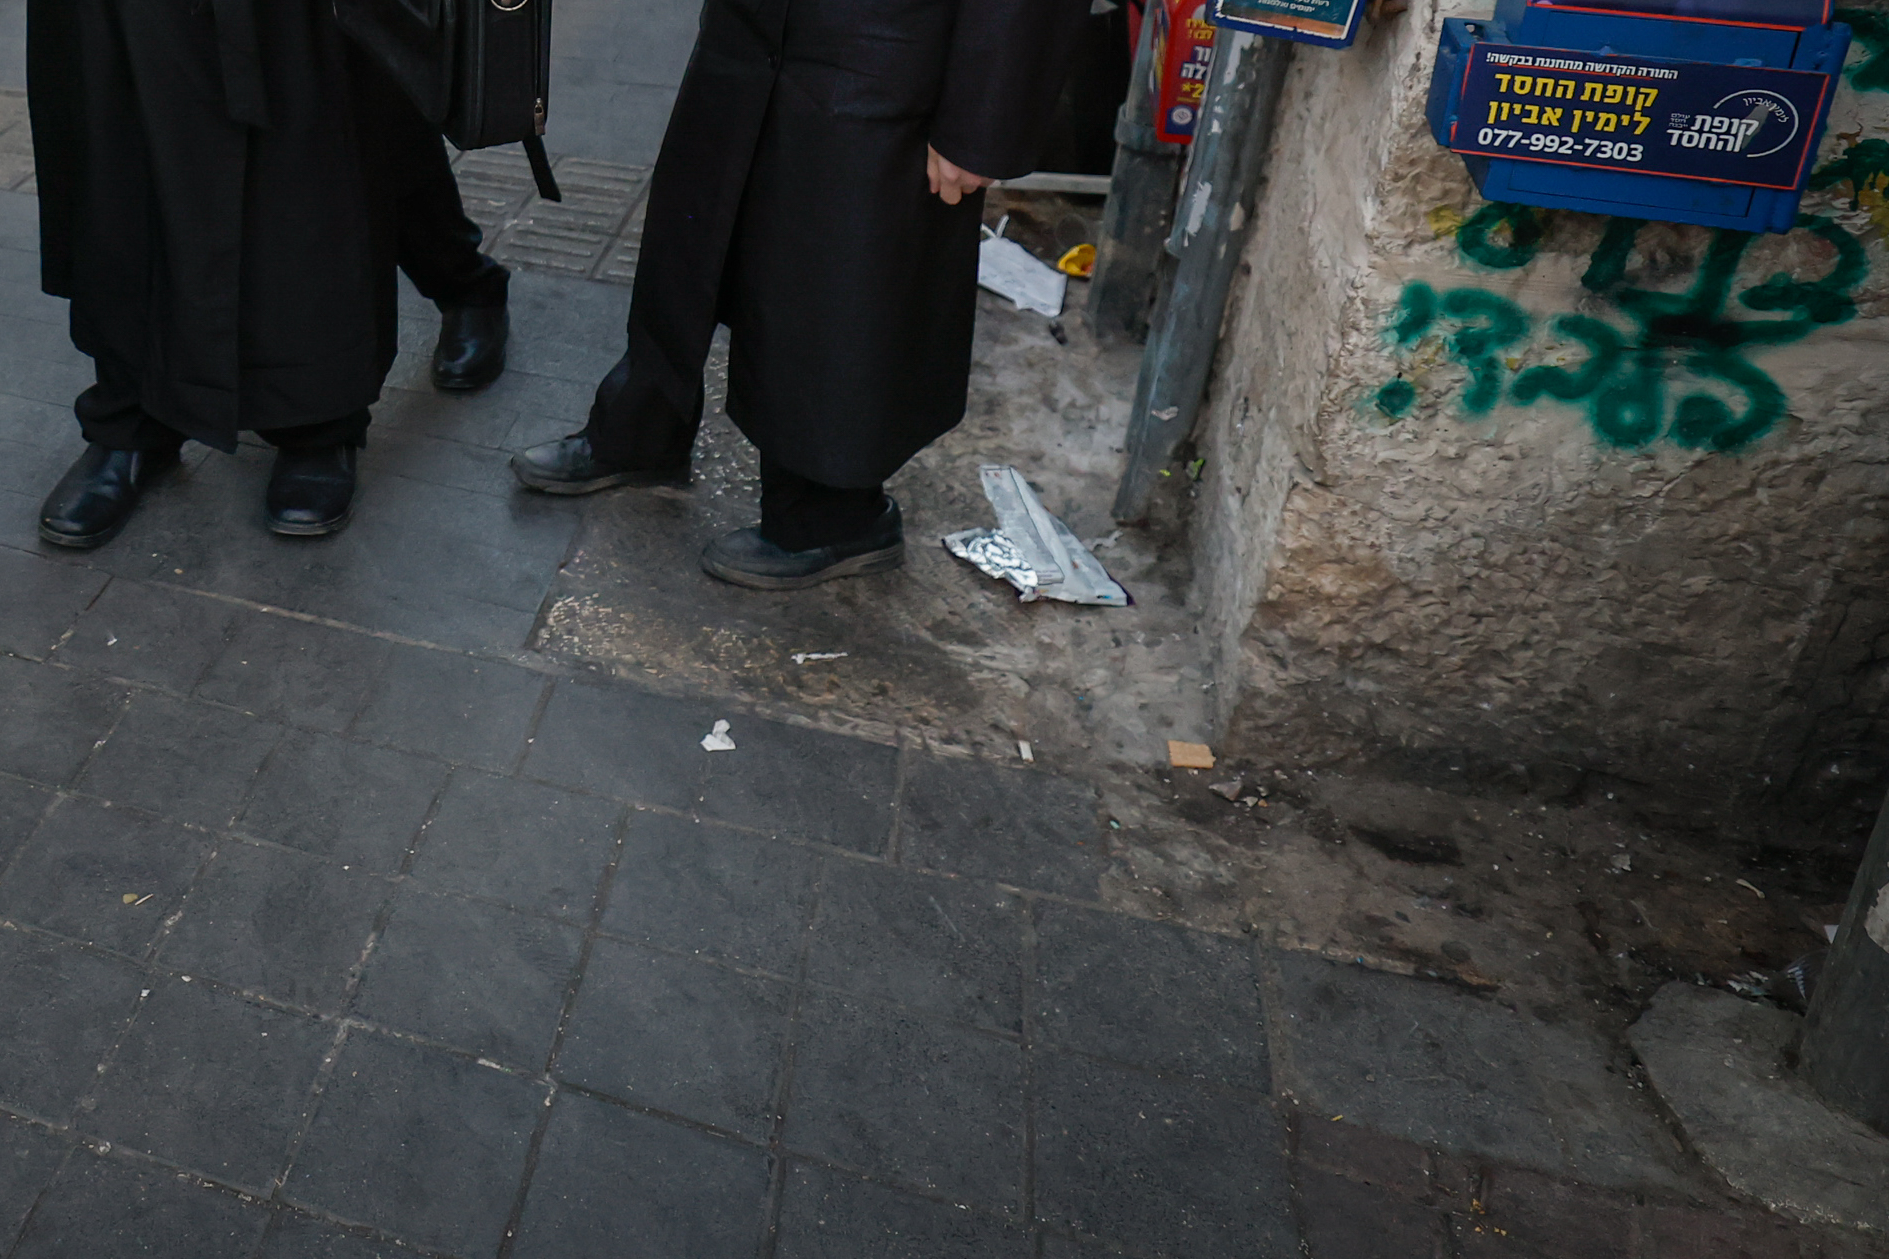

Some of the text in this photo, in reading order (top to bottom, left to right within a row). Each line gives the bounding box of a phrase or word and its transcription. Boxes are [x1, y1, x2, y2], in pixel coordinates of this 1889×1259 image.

[1486, 52, 1679, 79] התורה הקדושה מתחננת בבקשה!
[1494, 74, 1658, 111] קופת החסד
[1488, 100, 1651, 135] לימין אביון
[1689, 115, 1758, 152] קופת
[1478, 127, 1644, 162] 077-992-7303
